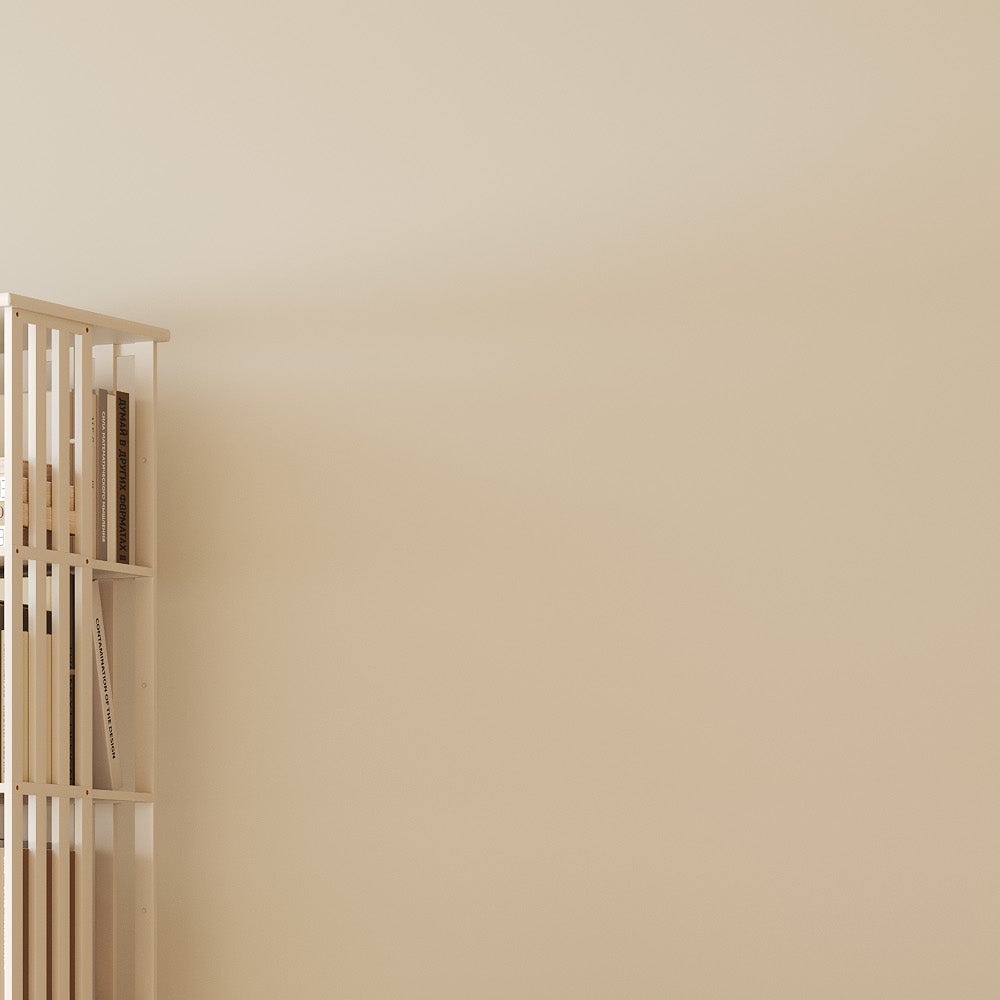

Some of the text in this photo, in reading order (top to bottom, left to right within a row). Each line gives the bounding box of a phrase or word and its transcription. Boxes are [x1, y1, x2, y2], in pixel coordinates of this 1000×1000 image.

[119, 398, 128, 437] ДУМАЙ
[119, 449, 127, 491] ДРУГИХ
[119, 494, 127, 548] ФОРМАТАХ
